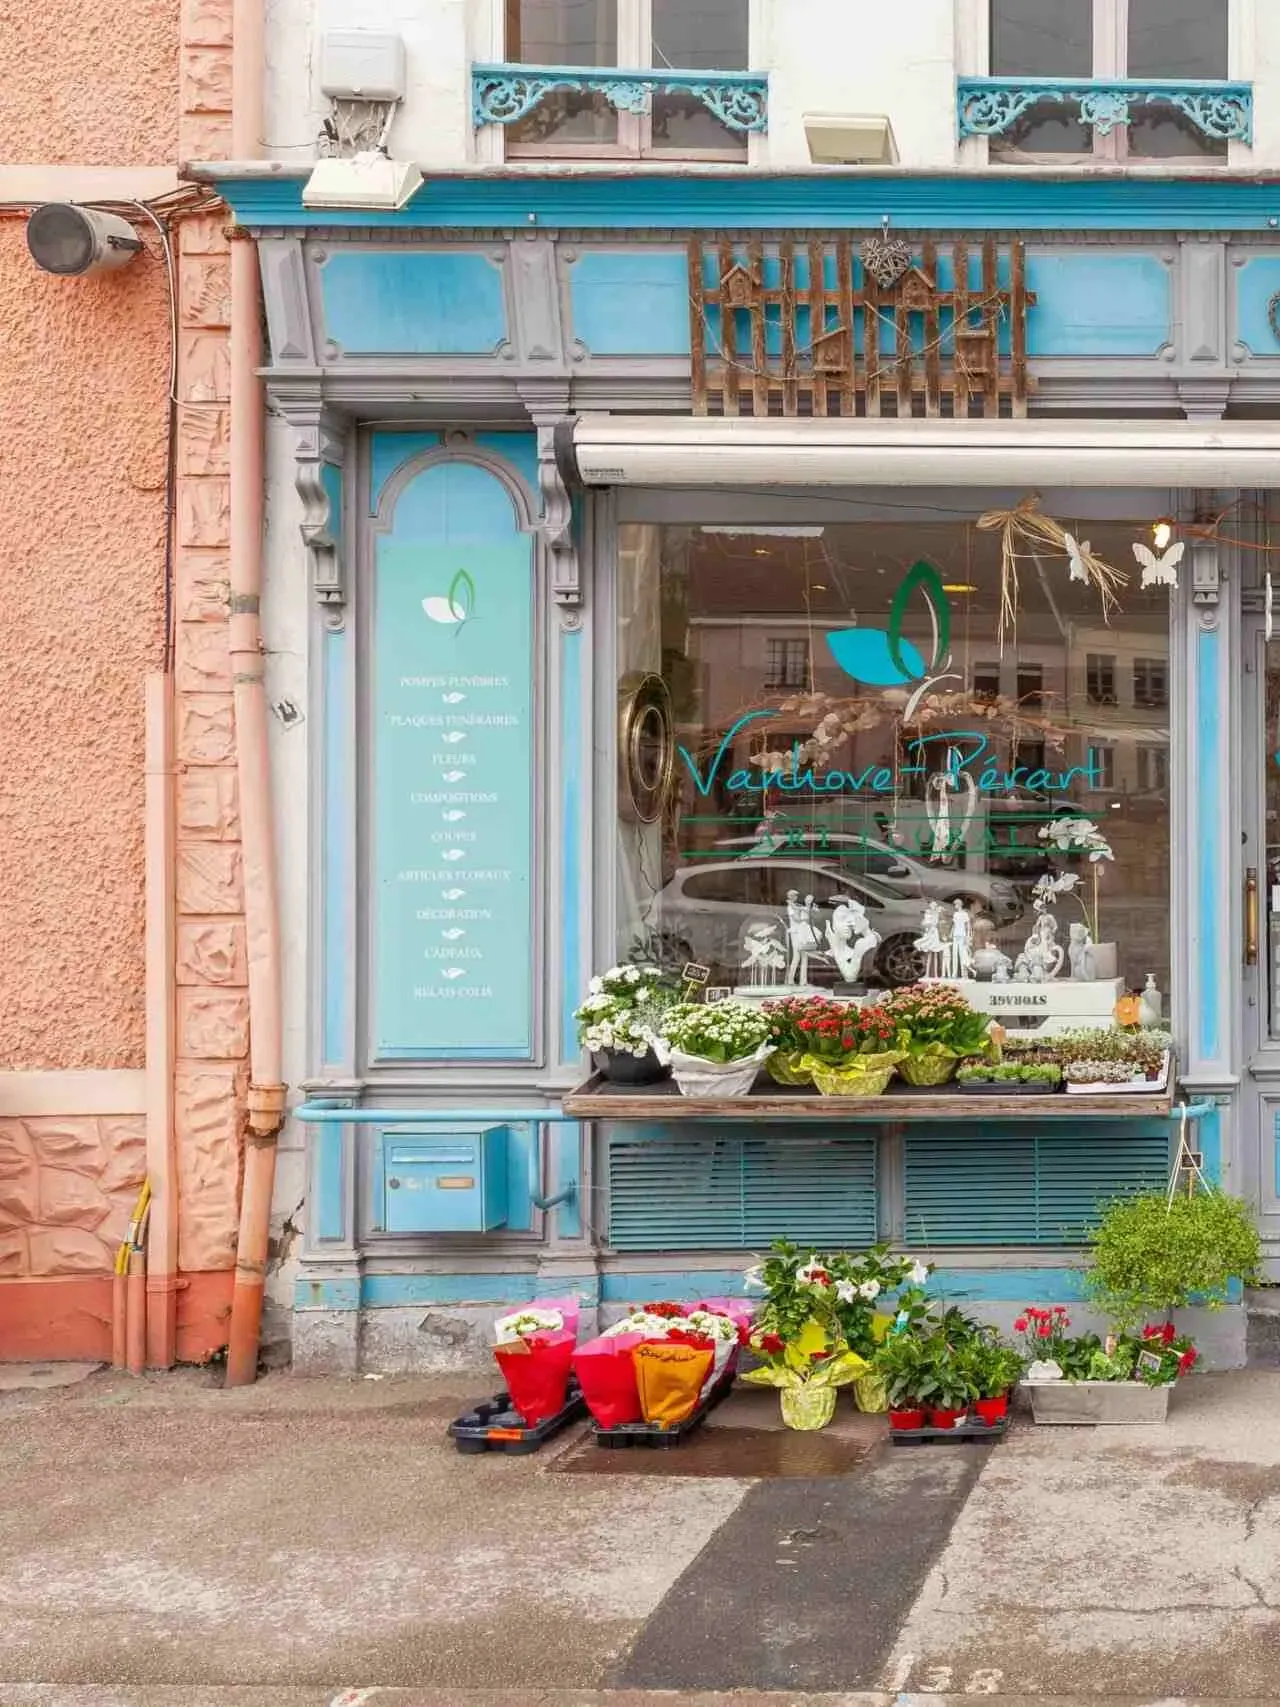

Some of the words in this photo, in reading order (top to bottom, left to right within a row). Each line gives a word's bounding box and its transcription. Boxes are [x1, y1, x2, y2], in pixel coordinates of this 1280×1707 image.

[432, 753, 476, 765] FLEURS
[410, 791, 498, 803] COMPOSITIONS
[424, 946, 483, 958] CADEAUX
[988, 994, 1048, 1006] STORAGE
